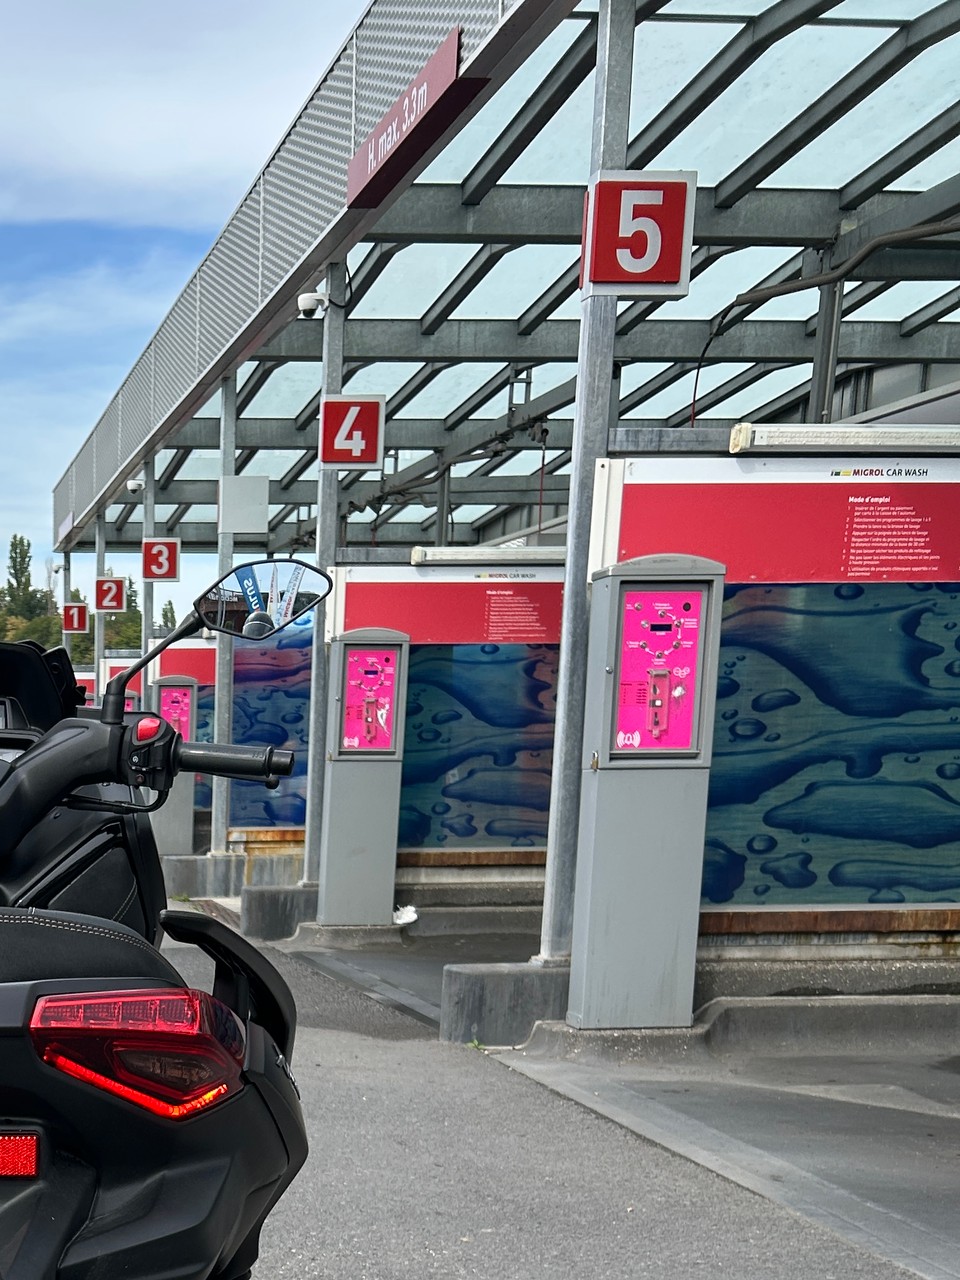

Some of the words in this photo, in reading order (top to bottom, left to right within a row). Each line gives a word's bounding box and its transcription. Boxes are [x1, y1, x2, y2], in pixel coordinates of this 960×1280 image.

[368, 138, 377, 175] H.
[379, 117, 400, 162] max.
[616, 190, 664, 273] 5
[334, 406, 366, 457] 4
[852, 468, 884, 477] MIGROL
[886, 469, 903, 477] CAR
[904, 468, 929, 477] WASH
[150, 544, 169, 575] 3
[102, 581, 118, 607] 2
[69, 607, 79, 629] 1
